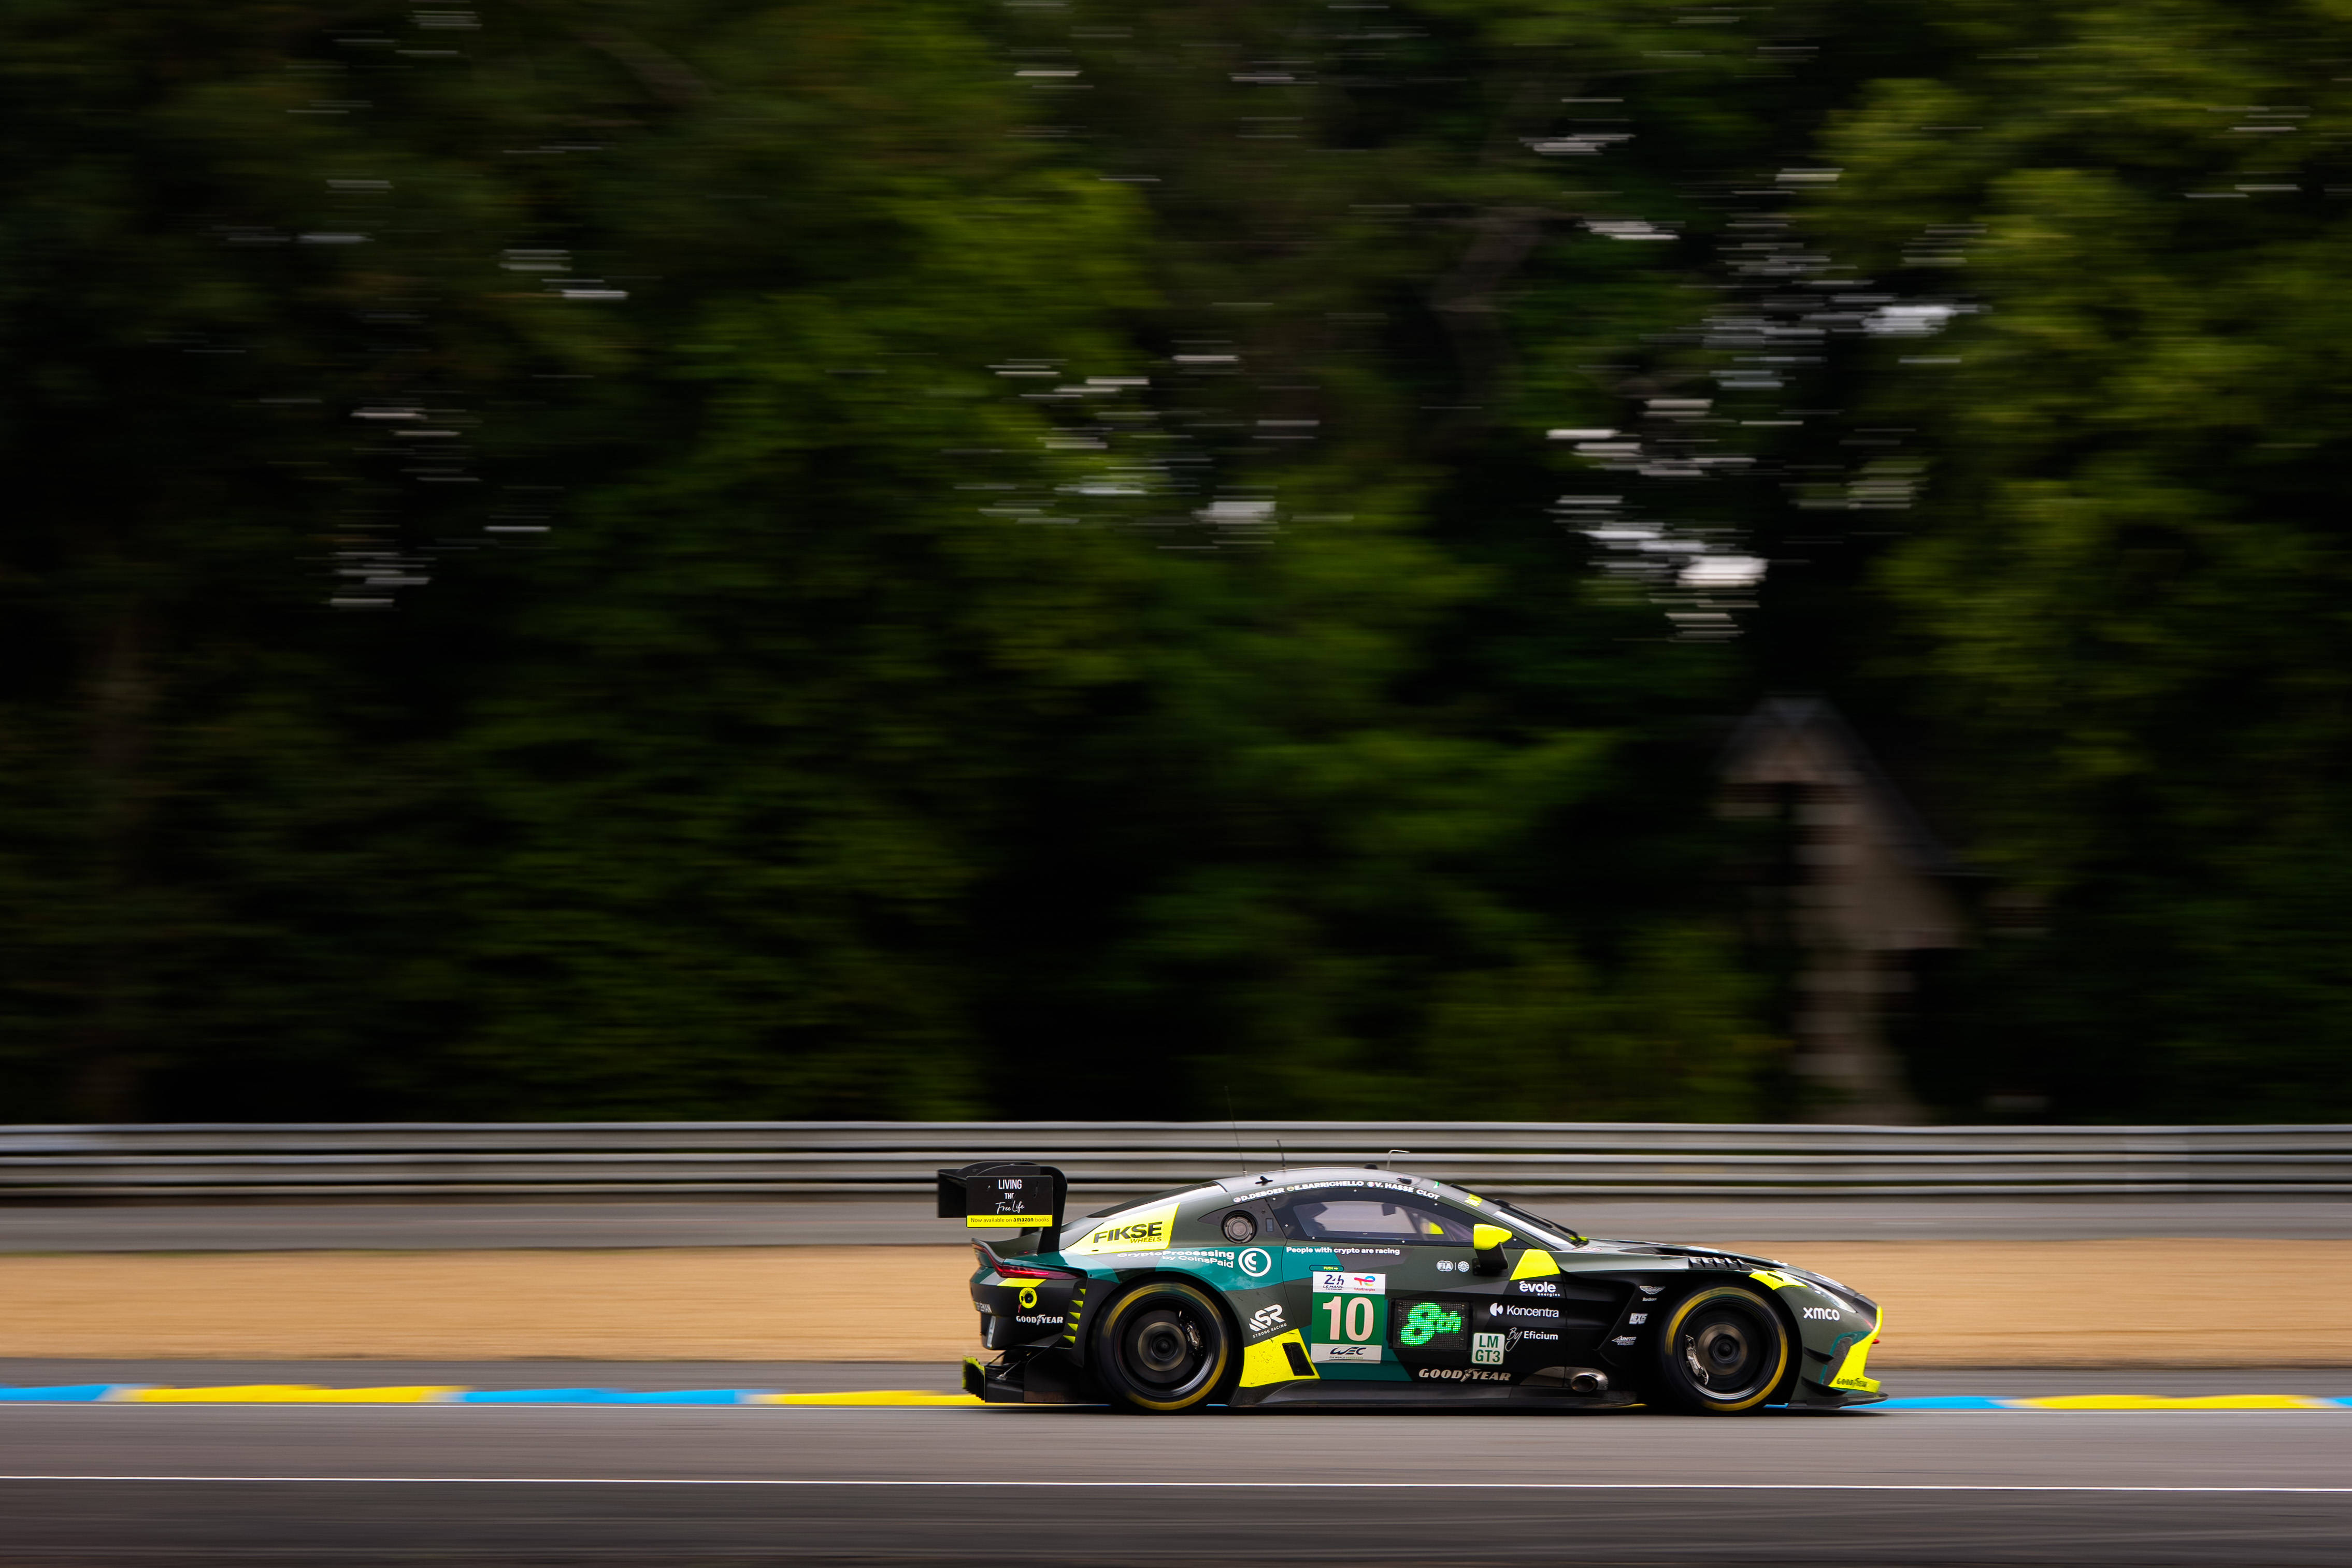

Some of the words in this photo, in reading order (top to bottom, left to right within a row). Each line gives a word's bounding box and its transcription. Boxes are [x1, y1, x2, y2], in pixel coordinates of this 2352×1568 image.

[998, 1179, 1022, 1189] LIVING
[1241, 1188, 1285, 1201] D.DEBOER
[1294, 1181, 1364, 1190] E.BARRICHELLO
[1384, 1183, 1414, 1193] HASSE
[1416, 1189, 1440, 1200] CLOT
[995, 1202, 1011, 1214] Free
[1012, 1200, 1025, 1213] Life
[1093, 1221, 1163, 1243] FIKSE
[1178, 1256, 1234, 1269] CoinsPaid
[1519, 1281, 1556, 1293] évole
[1507, 1305, 1559, 1318] Koncentra
[1803, 1307, 1840, 1321] xmco
[1016, 1314, 1064, 1326] GOODYEAR
[1323, 1296, 1374, 1342] 10
[1401, 1302, 1461, 1346] 8th
[1253, 1330, 1270, 1339] STRONG
[1271, 1324, 1287, 1332] RACING
[1479, 1335, 1499, 1348] LM
[1505, 1327, 1523, 1351] By
[1524, 1331, 1558, 1340] Eficium
[1330, 1347, 1367, 1355] WEC
[1475, 1349, 1500, 1362] GT3
[1419, 1368, 1511, 1383] GOODYEAR
